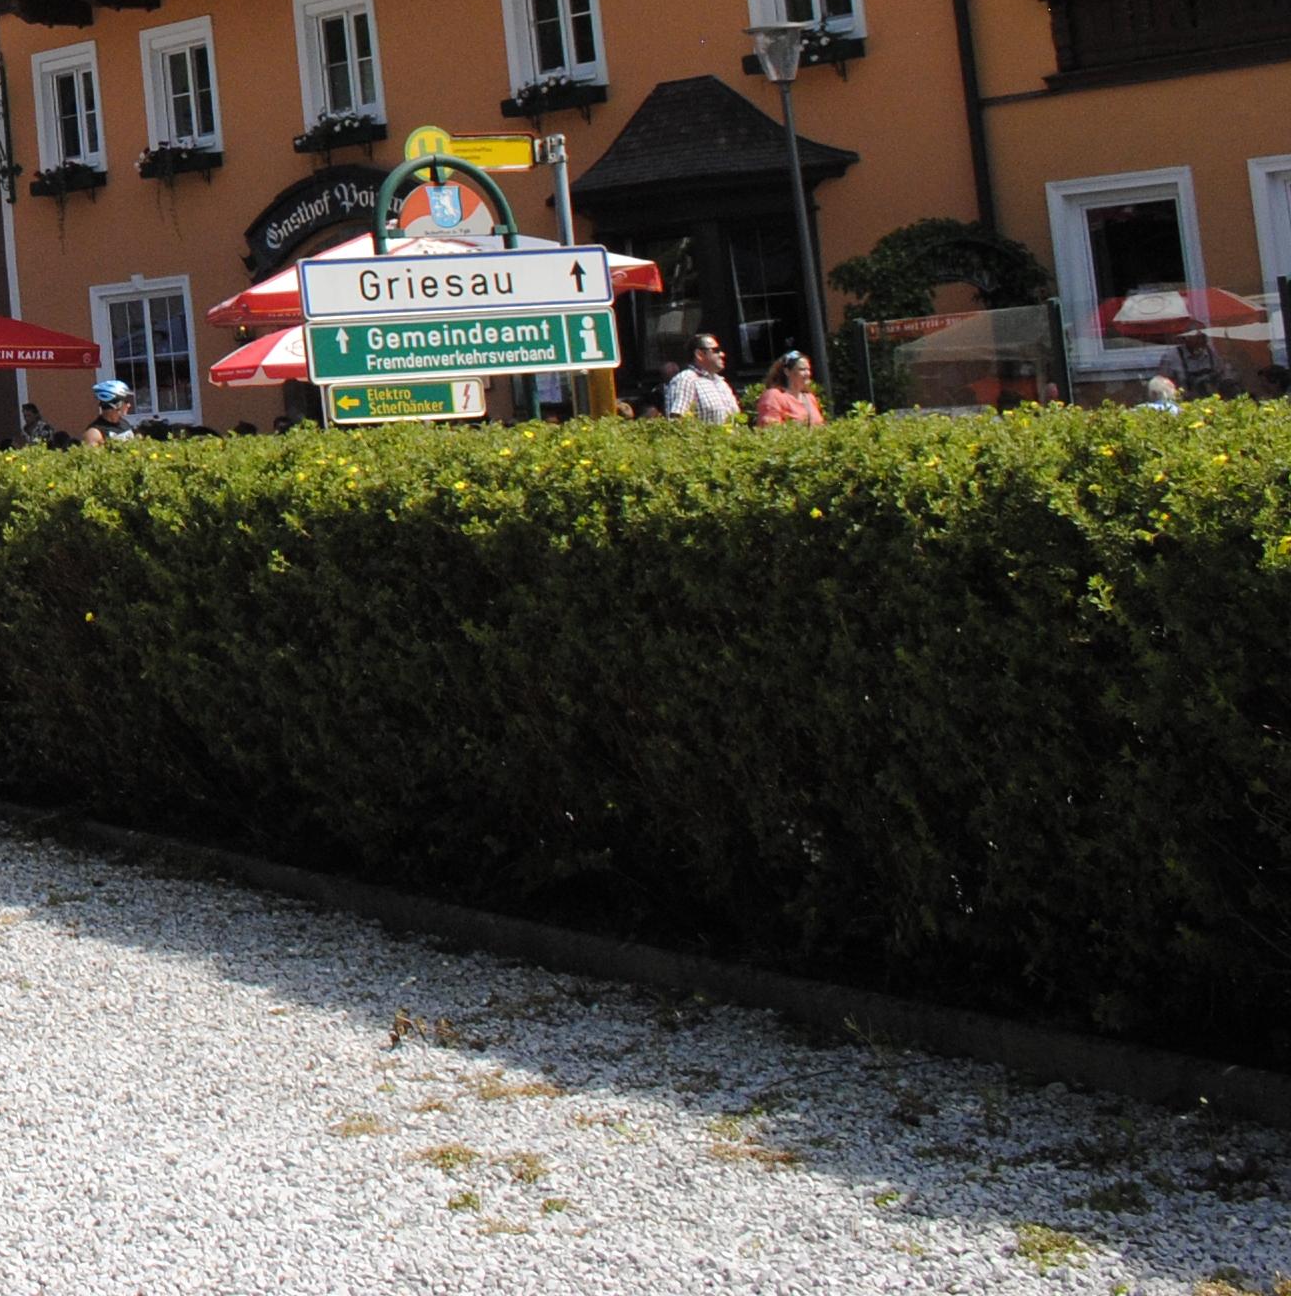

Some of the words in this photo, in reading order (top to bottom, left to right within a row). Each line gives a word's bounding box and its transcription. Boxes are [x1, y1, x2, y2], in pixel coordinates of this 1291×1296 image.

[266, 189, 331, 249] Gasthof
[359, 268, 514, 301] Griesau
[367, 320, 550, 350] Gemeindeamt
[17, 350, 54, 361] KAISER
[366, 345, 556, 371] Fremdenverkehrsverband
[367, 387, 412, 402] Elektro
[369, 398, 445, 416] Schefbänker
